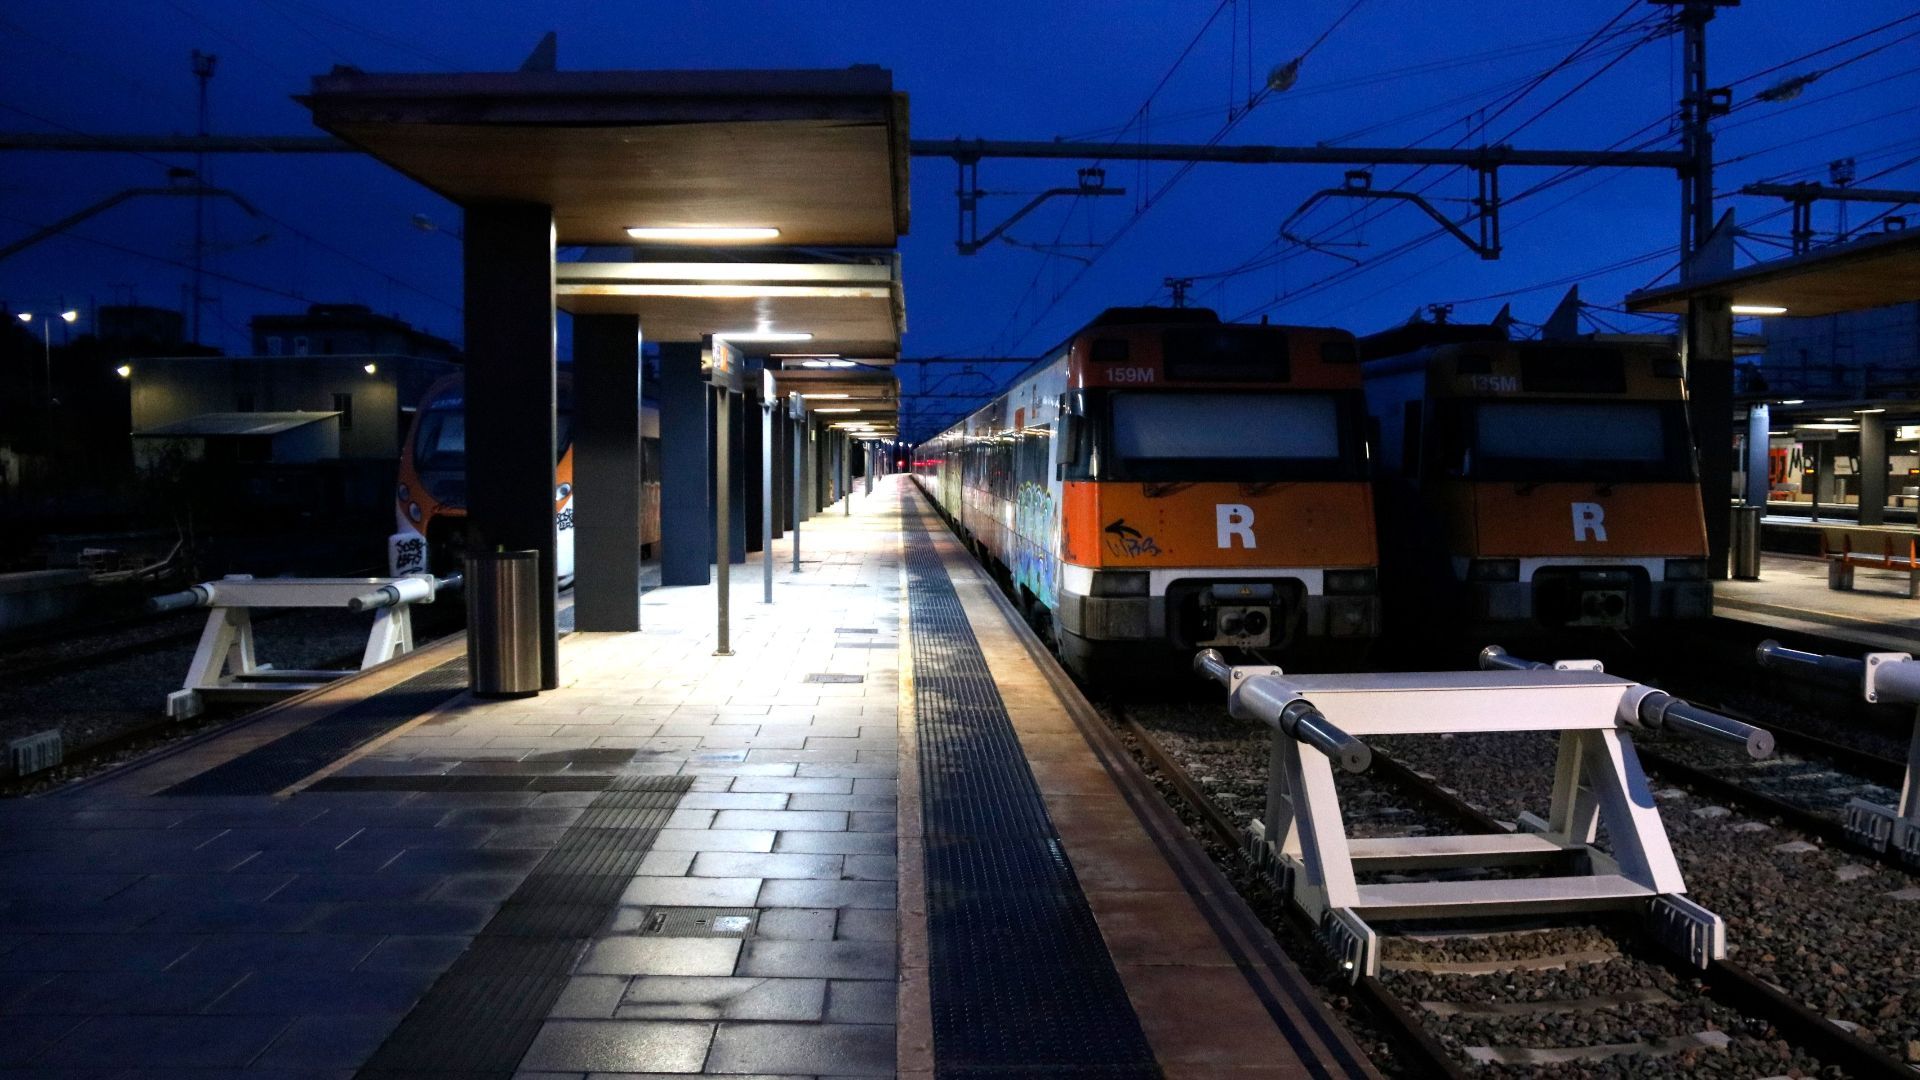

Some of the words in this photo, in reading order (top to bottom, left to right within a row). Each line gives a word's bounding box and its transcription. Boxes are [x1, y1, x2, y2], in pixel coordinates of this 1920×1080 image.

[1105, 367, 1154, 382] 159M
[1470, 374, 1517, 391] 135M
[1215, 503, 1257, 549] R
[1570, 501, 1608, 542] R
